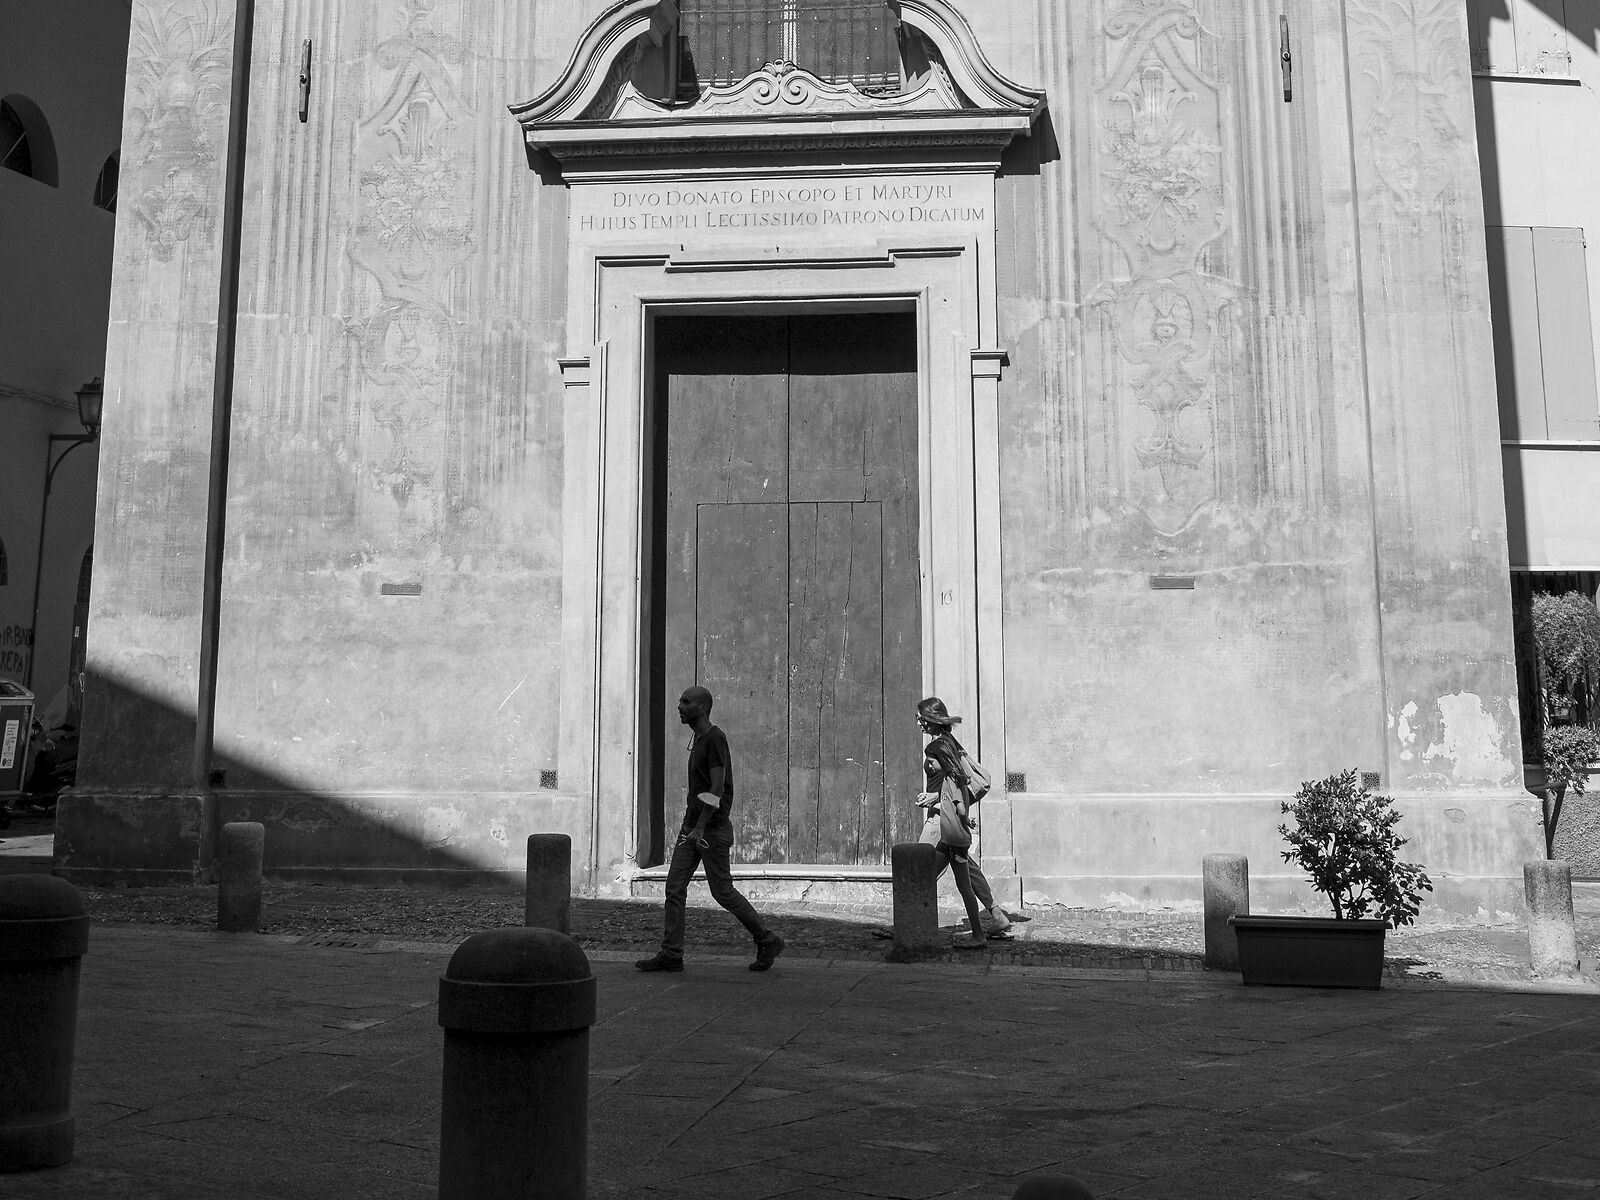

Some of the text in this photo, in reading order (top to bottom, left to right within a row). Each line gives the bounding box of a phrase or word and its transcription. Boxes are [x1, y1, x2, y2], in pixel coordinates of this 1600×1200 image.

[613, 183, 952, 207] DIVO DONATO EPISCOPO ET MARTYRI
[581, 206, 985, 231] HUIUS TEMPLI LECTISSIMO PATRONO DICATUM
